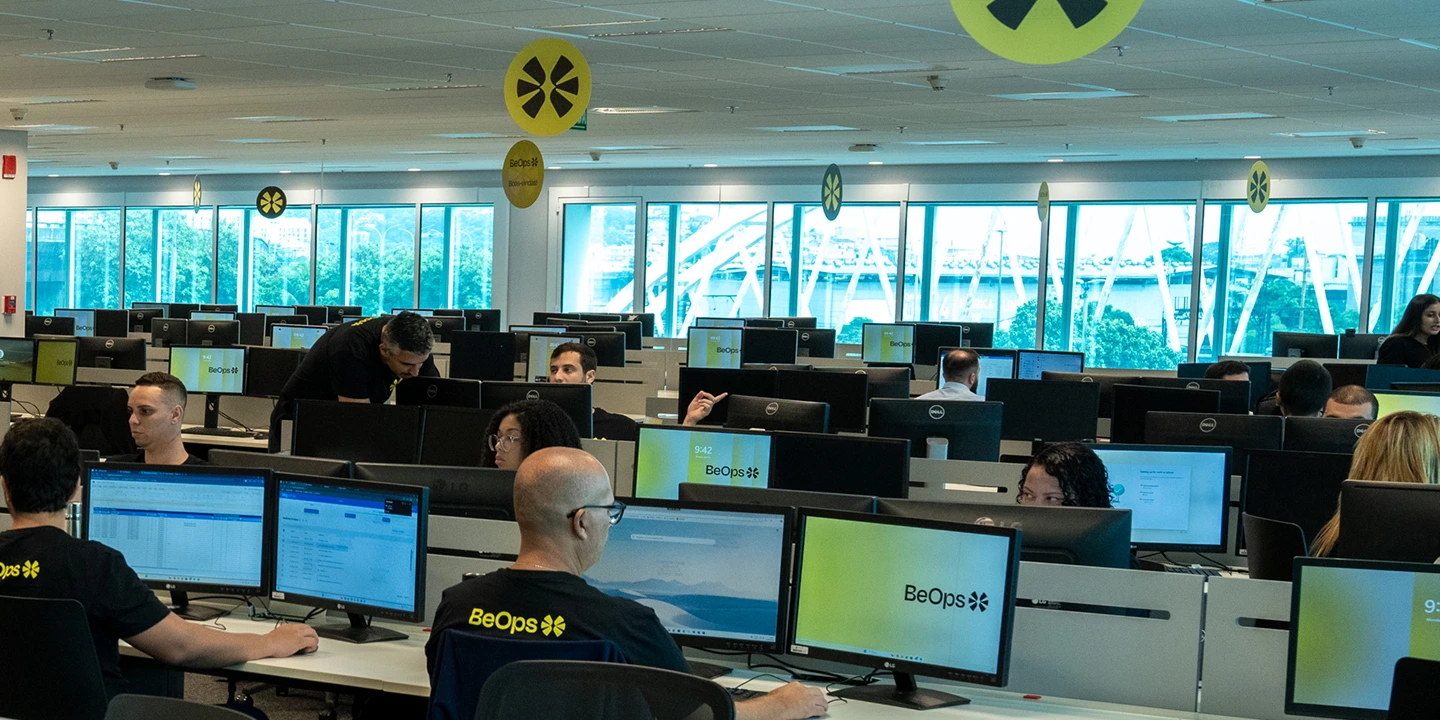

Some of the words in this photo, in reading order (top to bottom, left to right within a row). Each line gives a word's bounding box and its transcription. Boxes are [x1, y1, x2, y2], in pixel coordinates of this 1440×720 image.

[510, 159, 531, 168] BeOps
[717, 346, 739, 354] BeOps
[208, 366, 230, 374] BeOps
[694, 446, 712, 455] 9:42
[706, 465, 745, 478] BeOps
[904, 584, 966, 609] BeOps
[468, 608, 538, 635] BeOps
